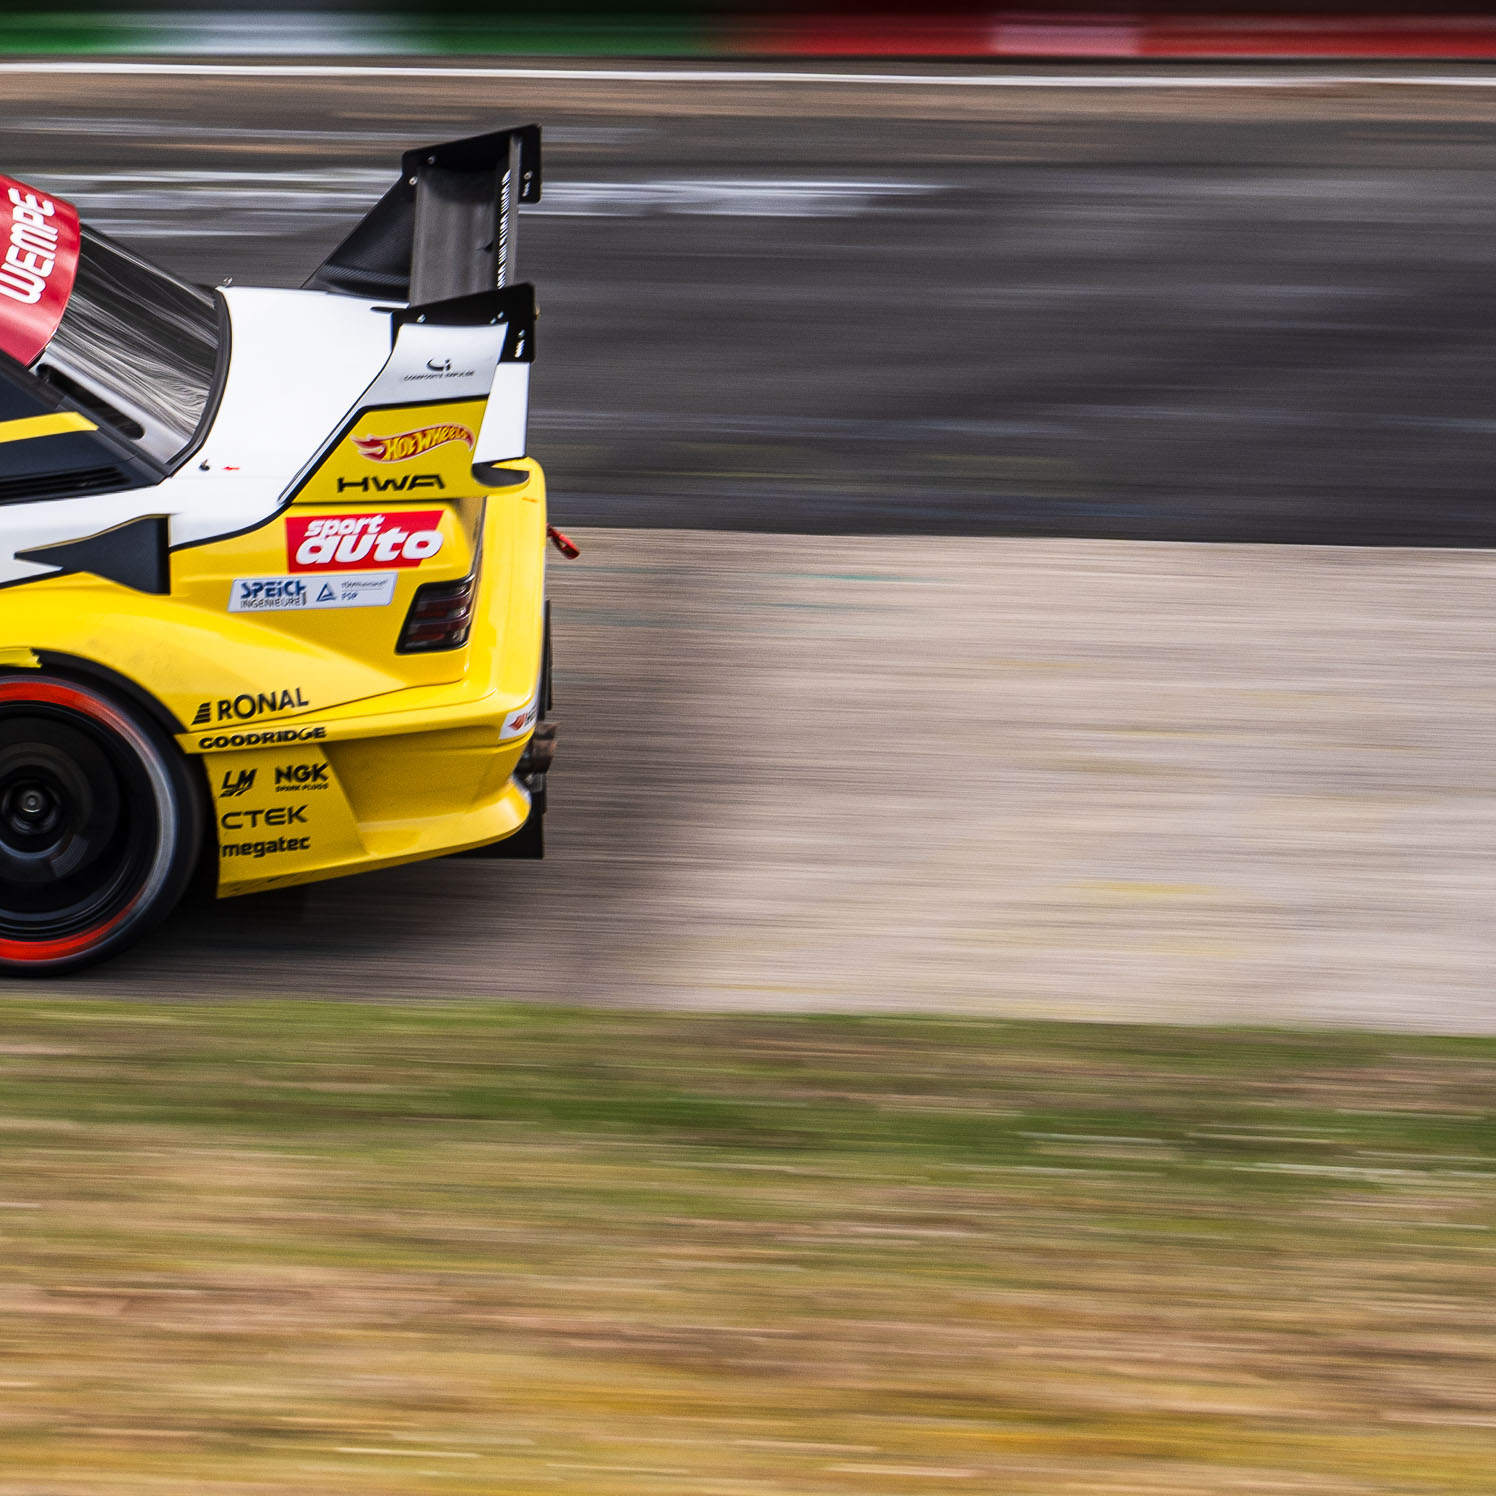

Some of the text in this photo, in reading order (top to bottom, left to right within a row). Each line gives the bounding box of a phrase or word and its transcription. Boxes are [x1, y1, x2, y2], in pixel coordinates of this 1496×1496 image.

[337, 473, 446, 493] HWA
[305, 513, 386, 538] sport
[295, 526, 445, 566] auto
[216, 687, 310, 722] RONAL
[197, 726, 328, 750] GOODRIDGE
[274, 760, 329, 785] NGK
[220, 804, 309, 830] CTEK
[221, 835, 311, 859] megatec
